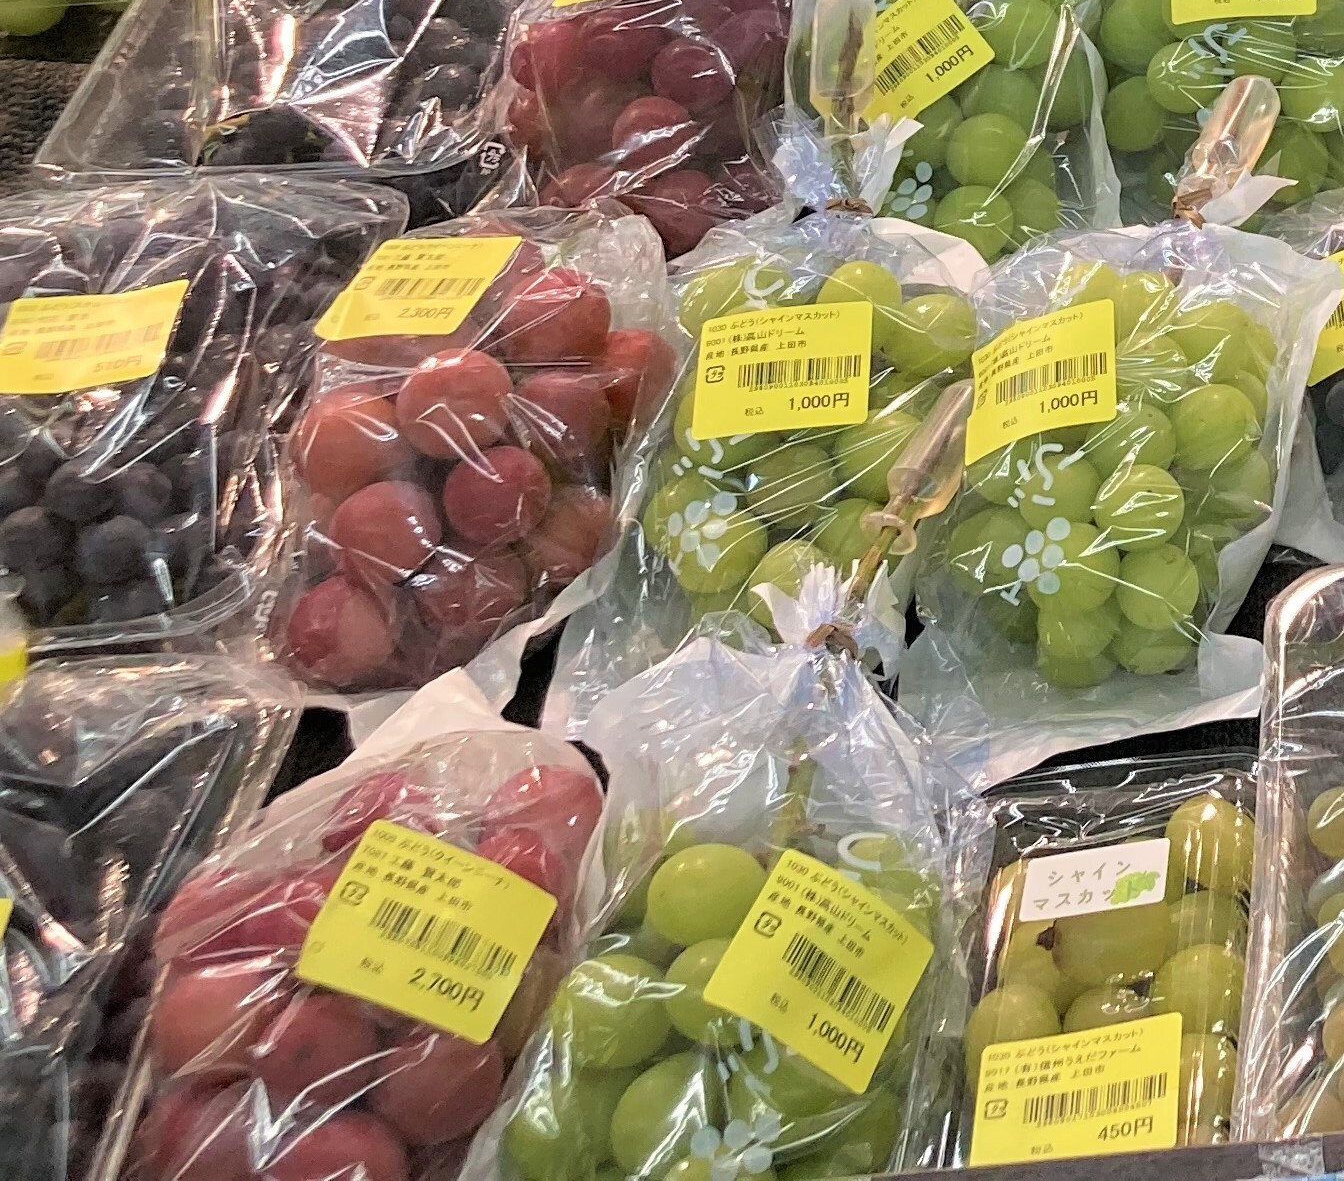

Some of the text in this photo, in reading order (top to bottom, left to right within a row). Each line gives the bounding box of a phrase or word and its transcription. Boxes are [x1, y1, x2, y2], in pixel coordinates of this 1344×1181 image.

[925, 44, 974, 83] 1,000円
[776, 340, 806, 351] 上田市
[789, 392, 850, 412] 1,000円
[1040, 390, 1098, 414] 1,000円
[1048, 861, 1131, 886] シャイン
[1033, 882, 1137, 909] マスカット
[408, 968, 485, 1011] 2,700円
[806, 1012, 865, 1063] 1,000円
[1097, 1116, 1154, 1141] 450円
